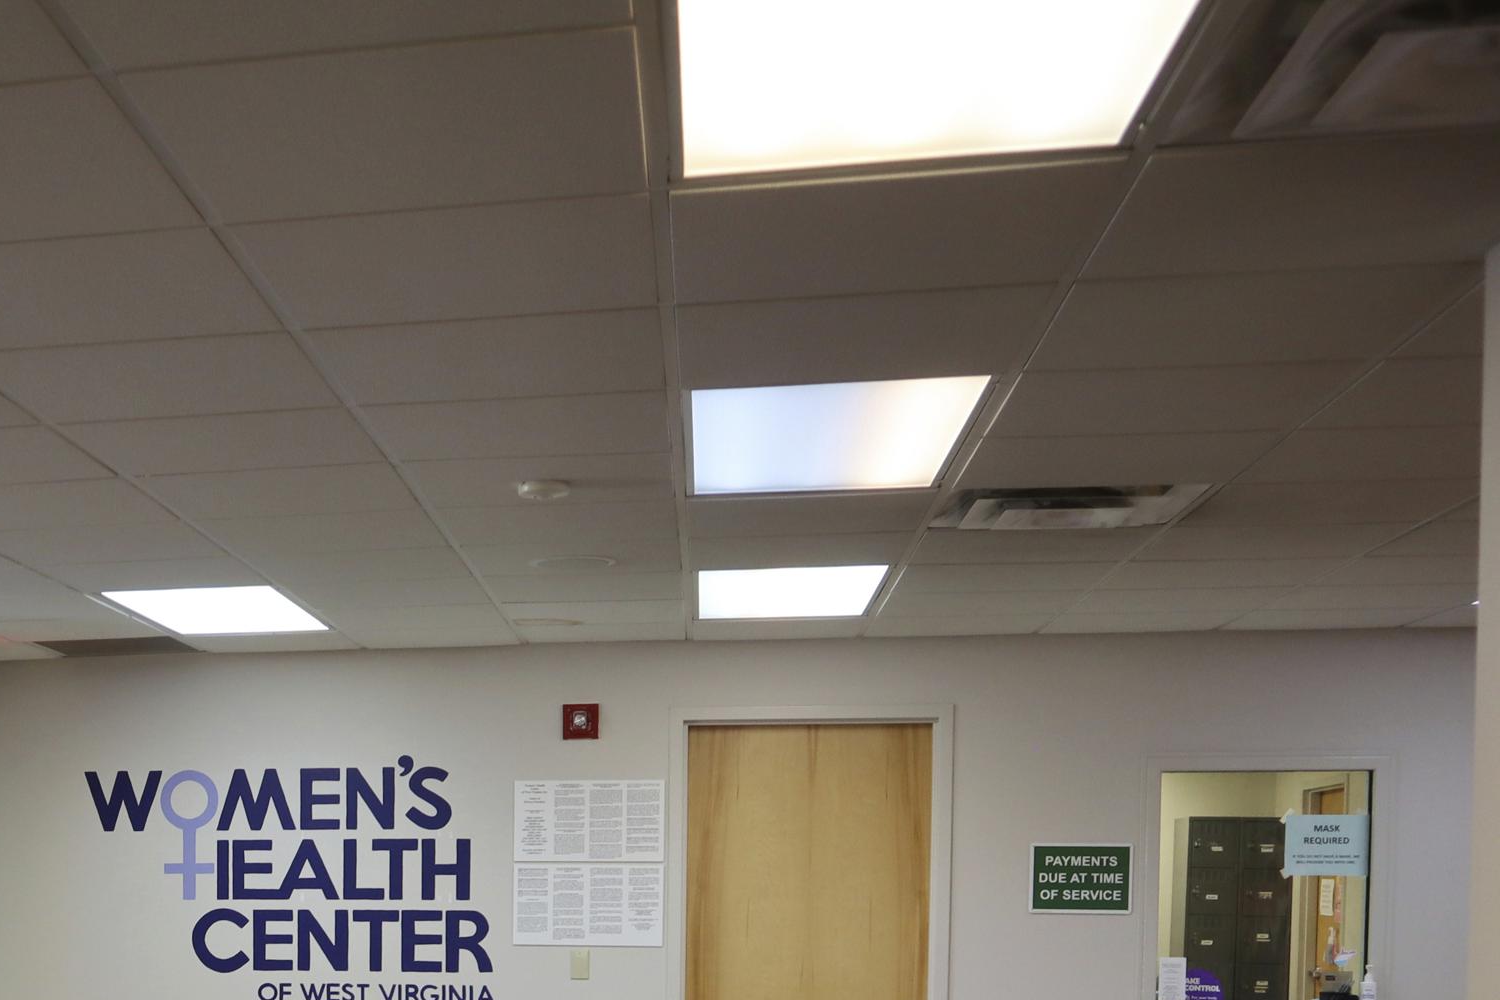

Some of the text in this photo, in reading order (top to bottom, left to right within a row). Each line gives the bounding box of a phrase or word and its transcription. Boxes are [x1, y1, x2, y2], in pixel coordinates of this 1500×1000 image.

[84, 755, 452, 832] WOMEN'S
[1313, 824, 1341, 832] MASK
[1303, 836, 1350, 845] REQUIRED
[1045, 855, 1118, 866] PAYMENTS
[1039, 872, 1124, 884] DUE AT TIME
[1040, 889, 1122, 901] OF SERVICE
[192, 908, 493, 973] CENTER
